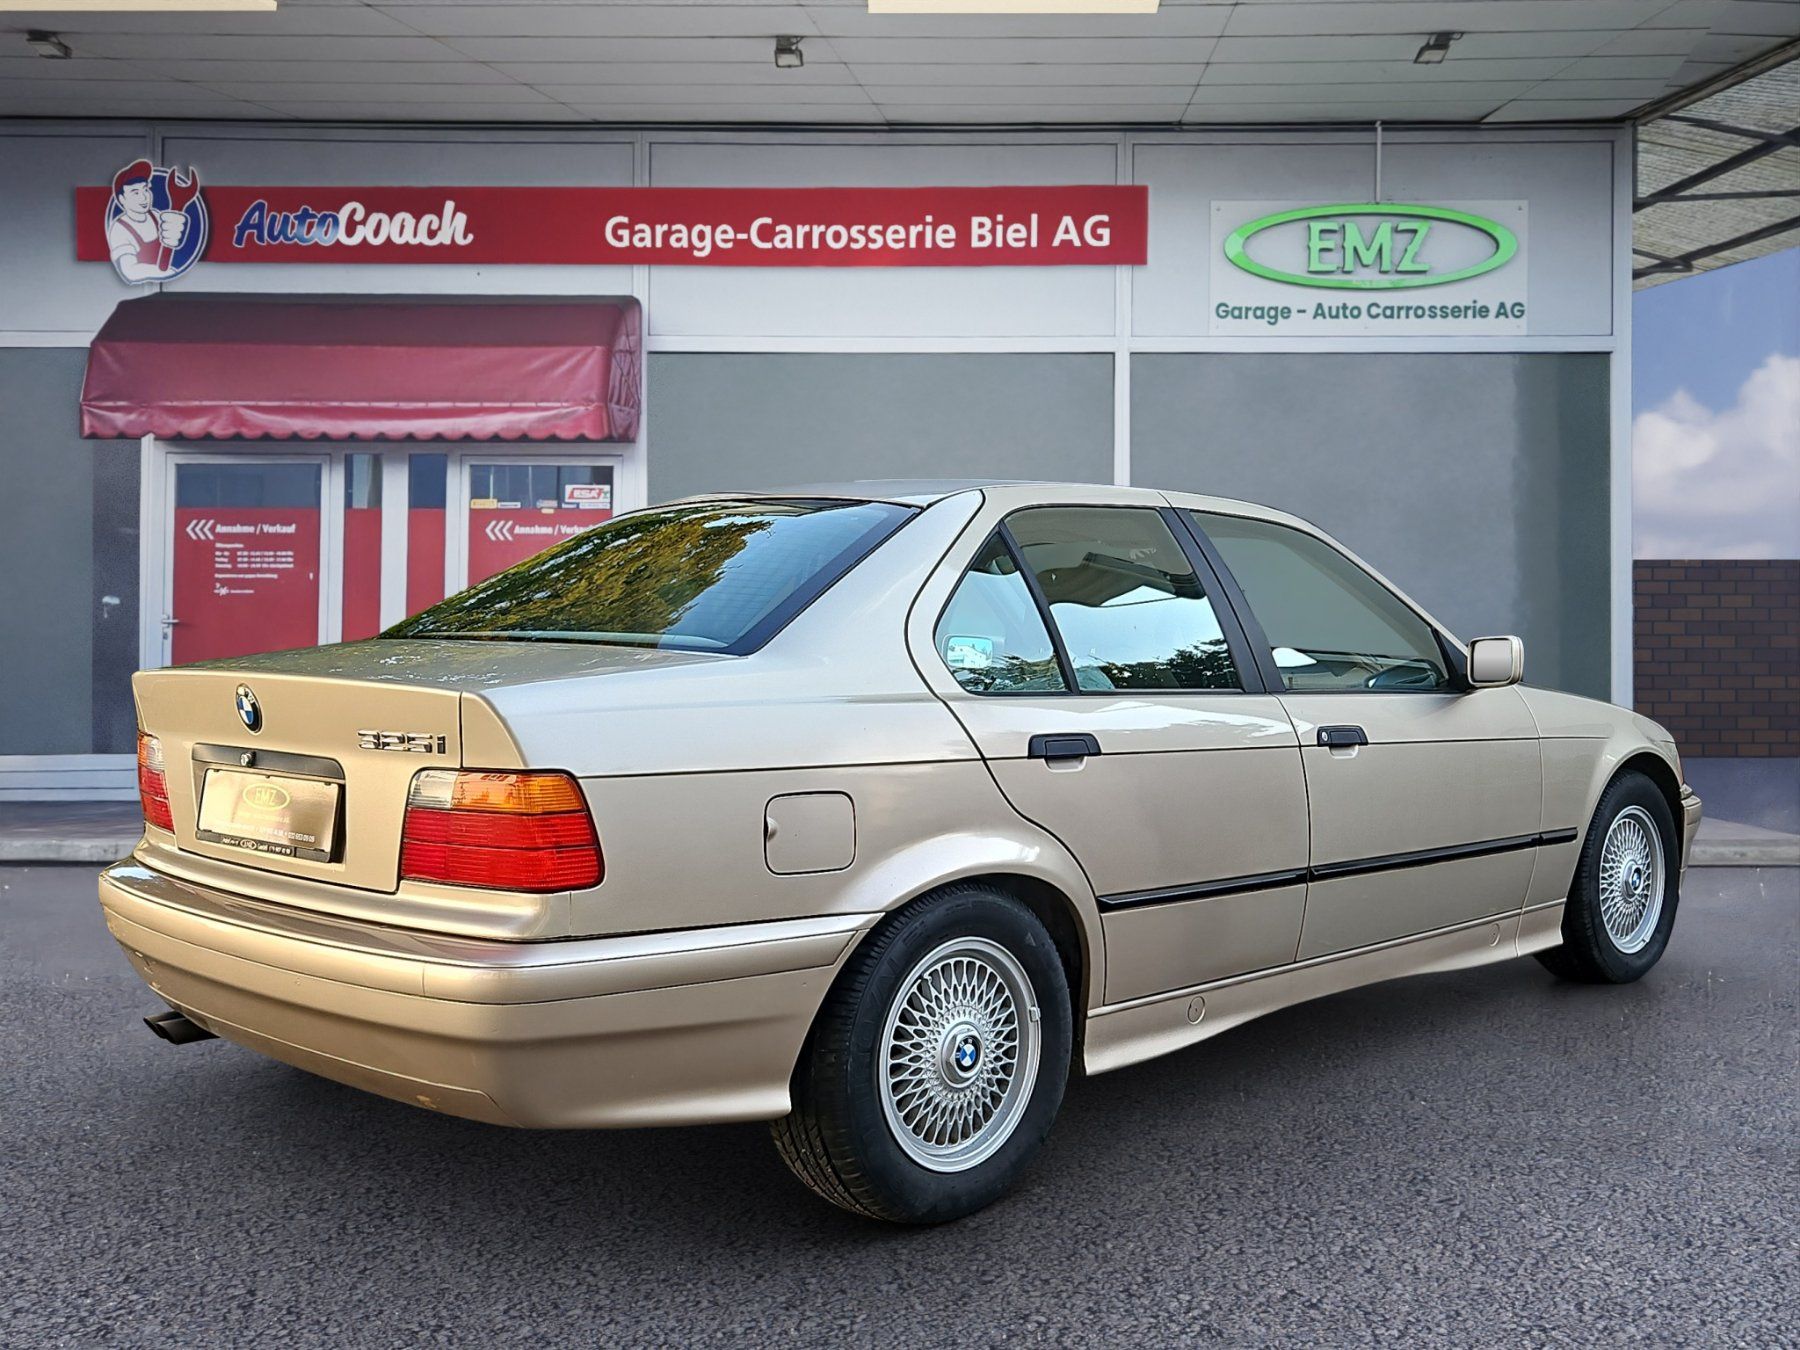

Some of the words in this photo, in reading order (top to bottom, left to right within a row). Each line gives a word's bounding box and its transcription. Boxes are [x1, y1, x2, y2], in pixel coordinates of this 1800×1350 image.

[233, 199, 474, 248] AutoCoach
[604, 215, 957, 257] Garage-Carrosserie
[970, 213, 1038, 249] Biel
[1051, 214, 1112, 247] AG
[1307, 221, 1431, 274] EMZ
[1215, 302, 1292, 326] Garage
[1312, 302, 1362, 320] Auto
[1366, 300, 1490, 320] Carrosserie
[1494, 301, 1526, 319] AG
[214, 523, 256, 534] Annahme
[262, 523, 297, 534] Verkauf
[513, 524, 554, 535] Annahme
[357, 729, 447, 755] 325i
